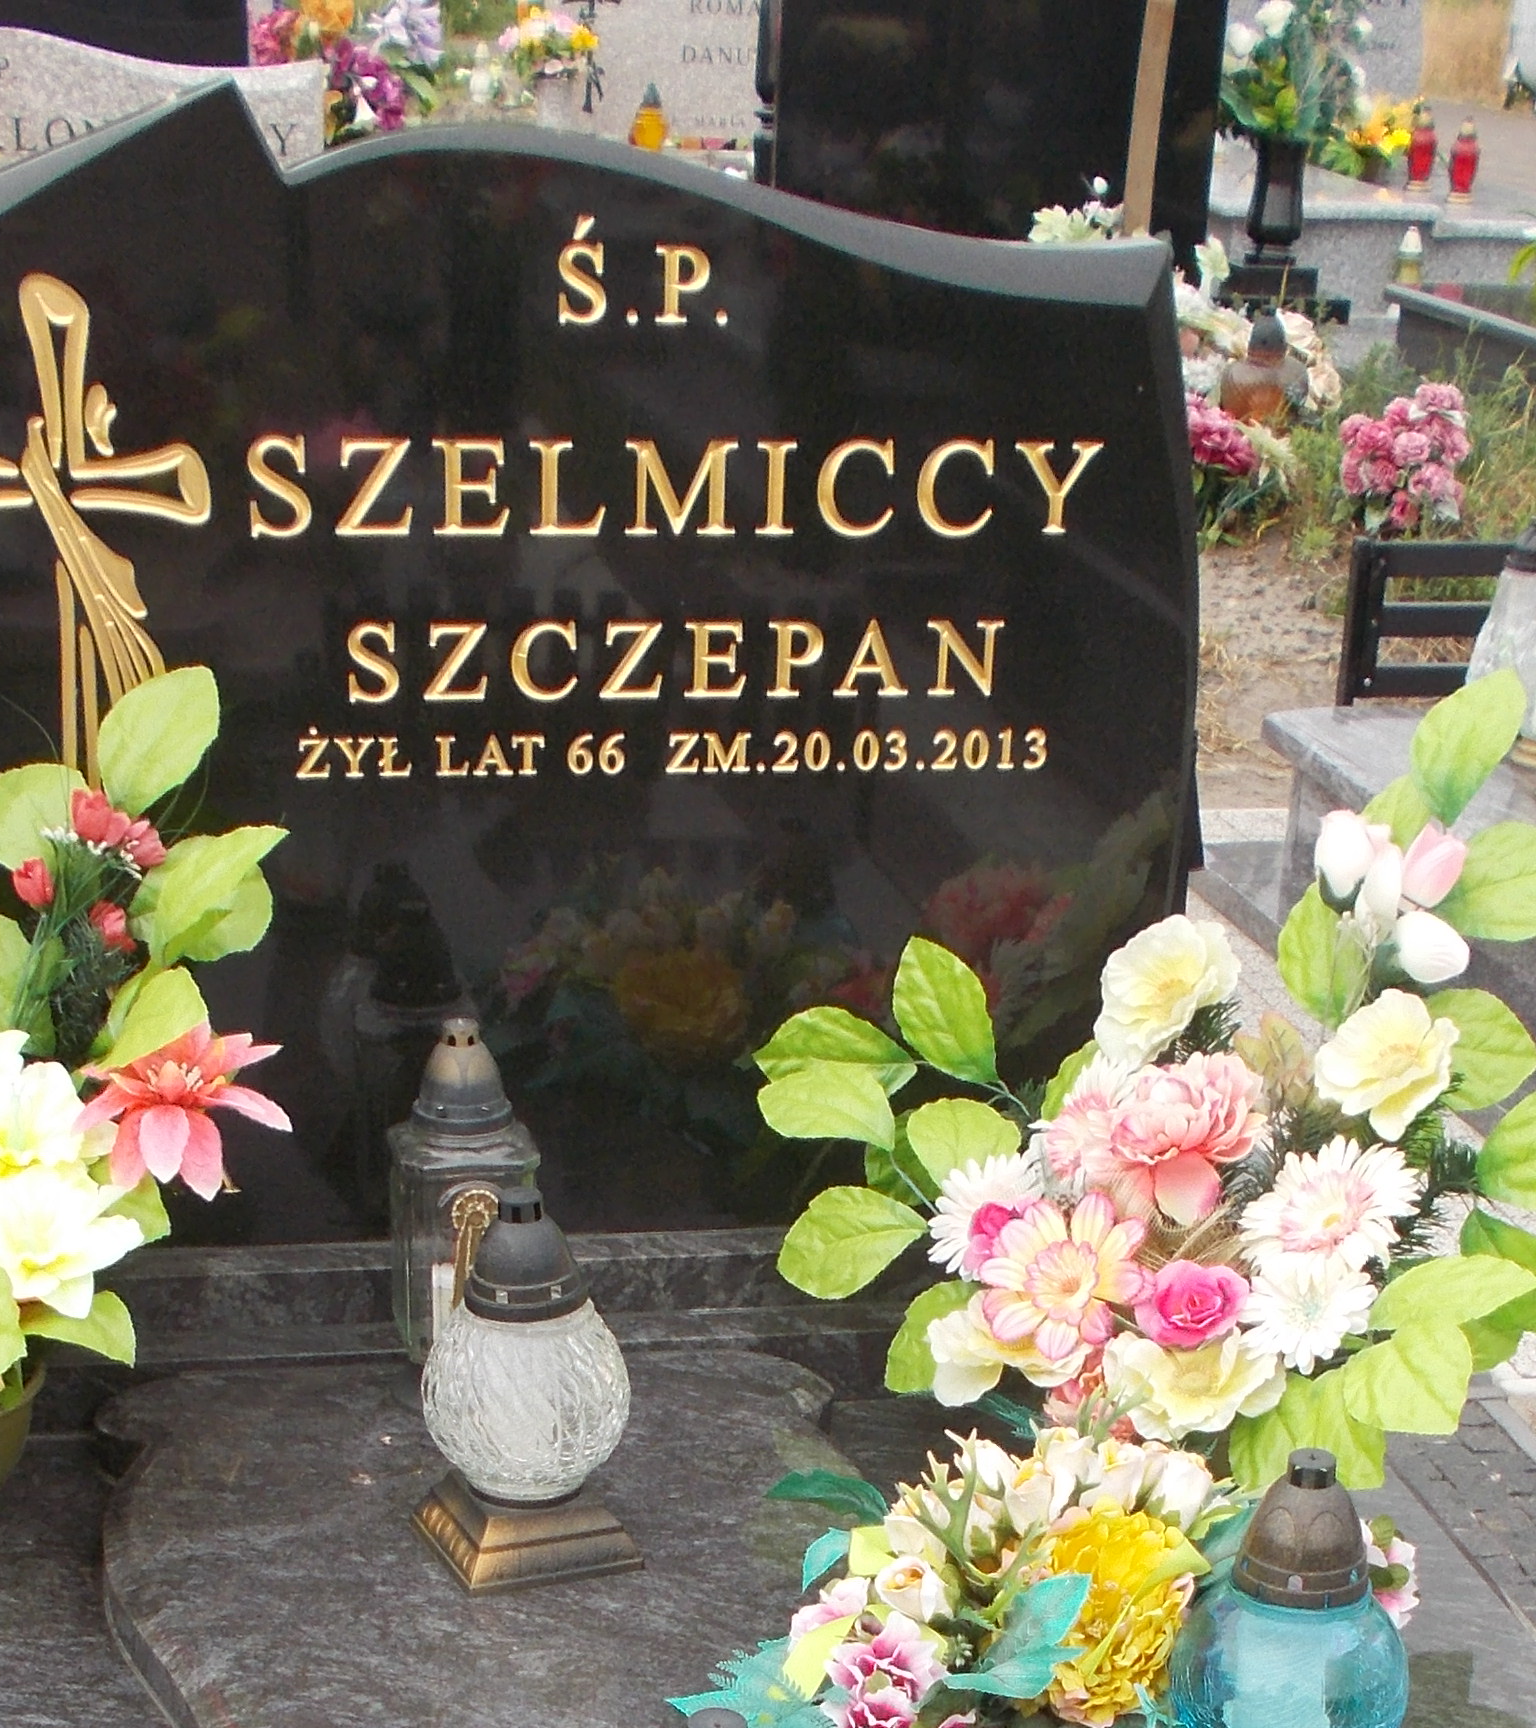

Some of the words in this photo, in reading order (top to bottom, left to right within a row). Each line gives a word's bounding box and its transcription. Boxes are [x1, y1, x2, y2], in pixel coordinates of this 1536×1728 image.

[681, 45, 757, 65] DANU
[557, 215, 731, 327] Ś.P.
[246, 433, 1106, 541] SZELMICCY
[346, 617, 1006, 706] SZCZEPAN
[295, 726, 412, 778] ŻYŁ
[434, 733, 546, 777] LAT
[566, 732, 626, 776] 66
[664, 727, 1049, 774] ZM.20.03.2013
